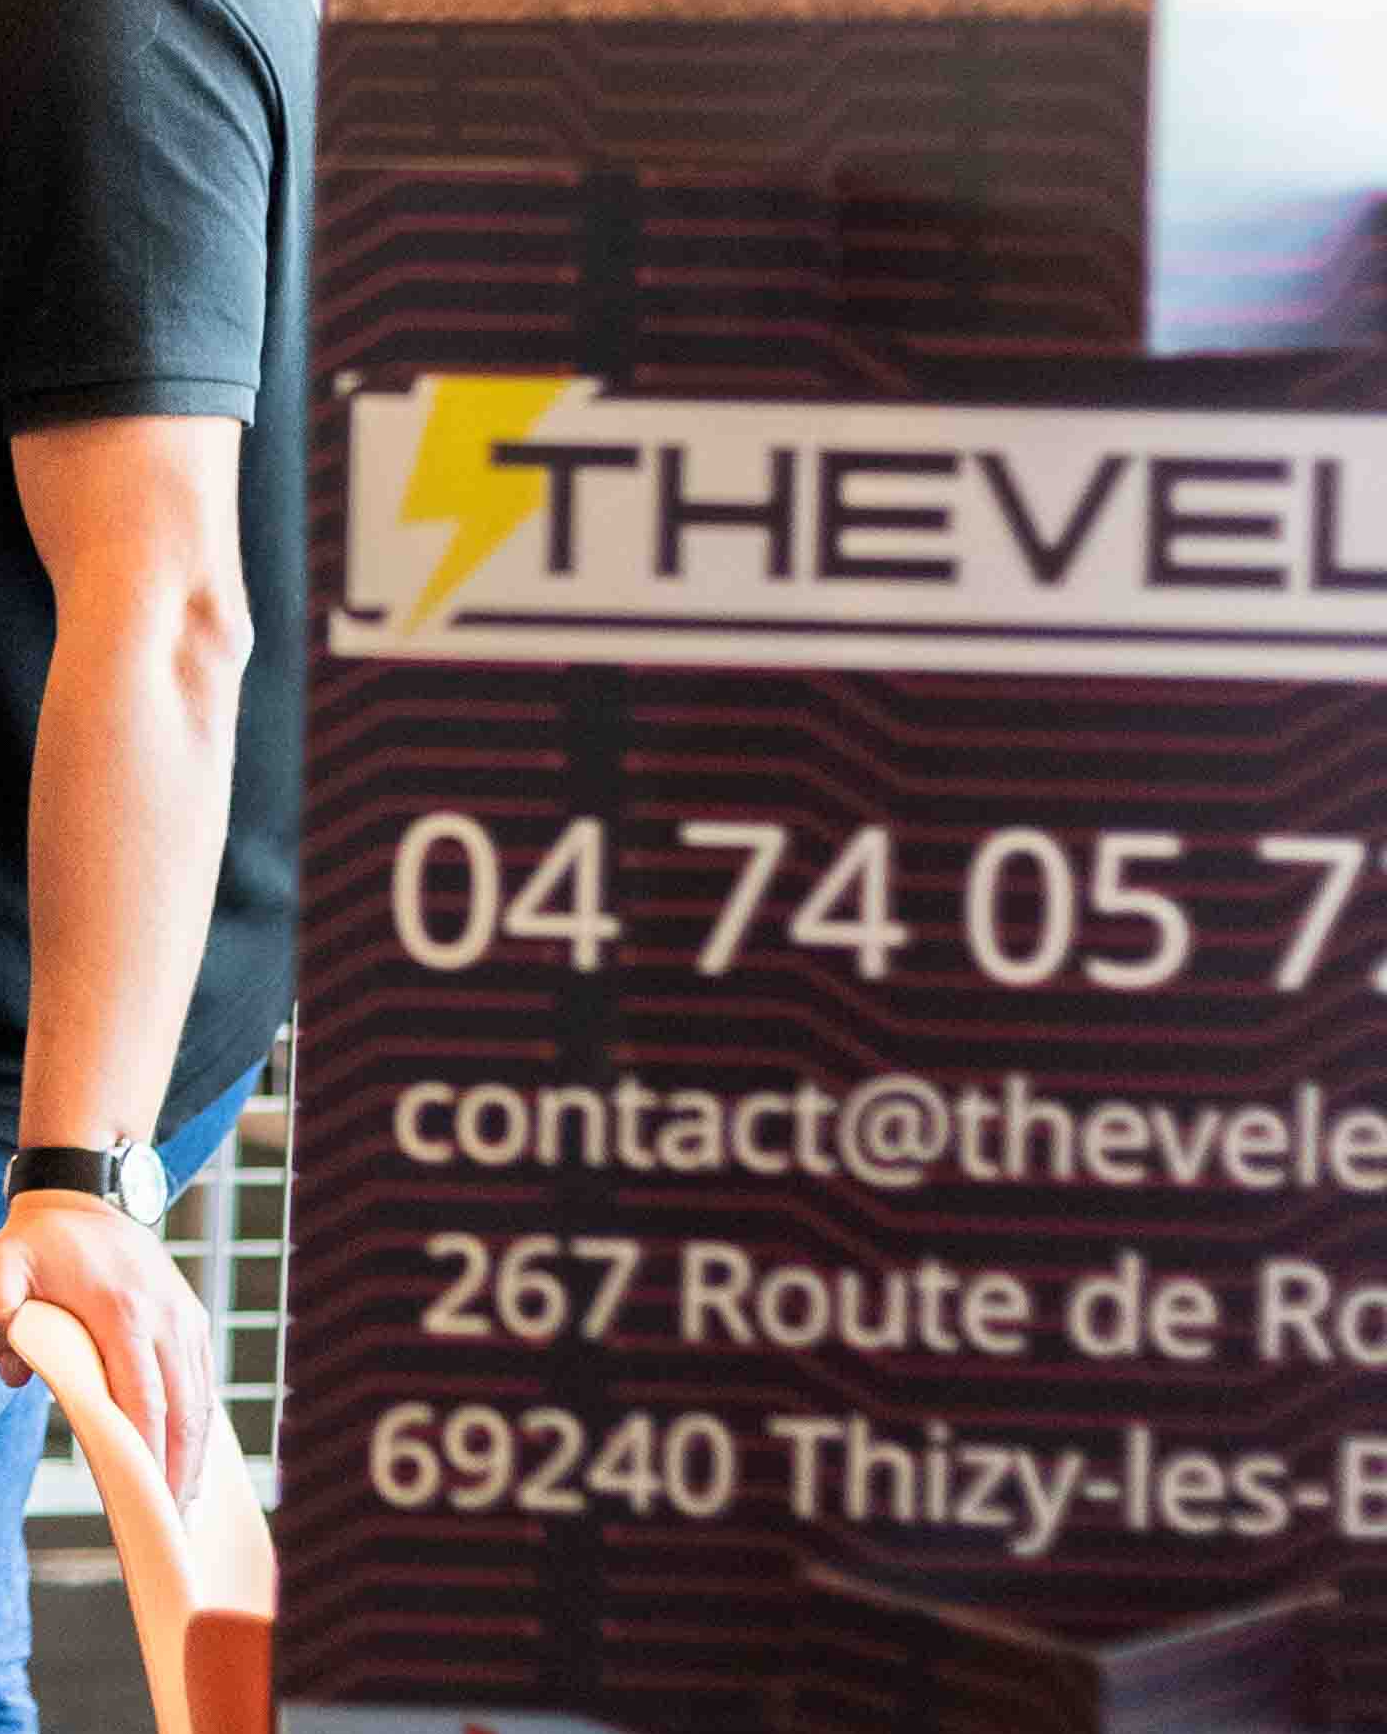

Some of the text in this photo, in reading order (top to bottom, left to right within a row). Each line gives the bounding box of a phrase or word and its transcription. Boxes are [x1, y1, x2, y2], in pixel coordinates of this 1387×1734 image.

[391, 810, 1387, 994] 04 74 05 7
[422, 1231, 641, 1342] 267
[678, 1239, 1030, 1355] Route
[1065, 1247, 1220, 1360] de
[368, 1401, 735, 1520] 69240
